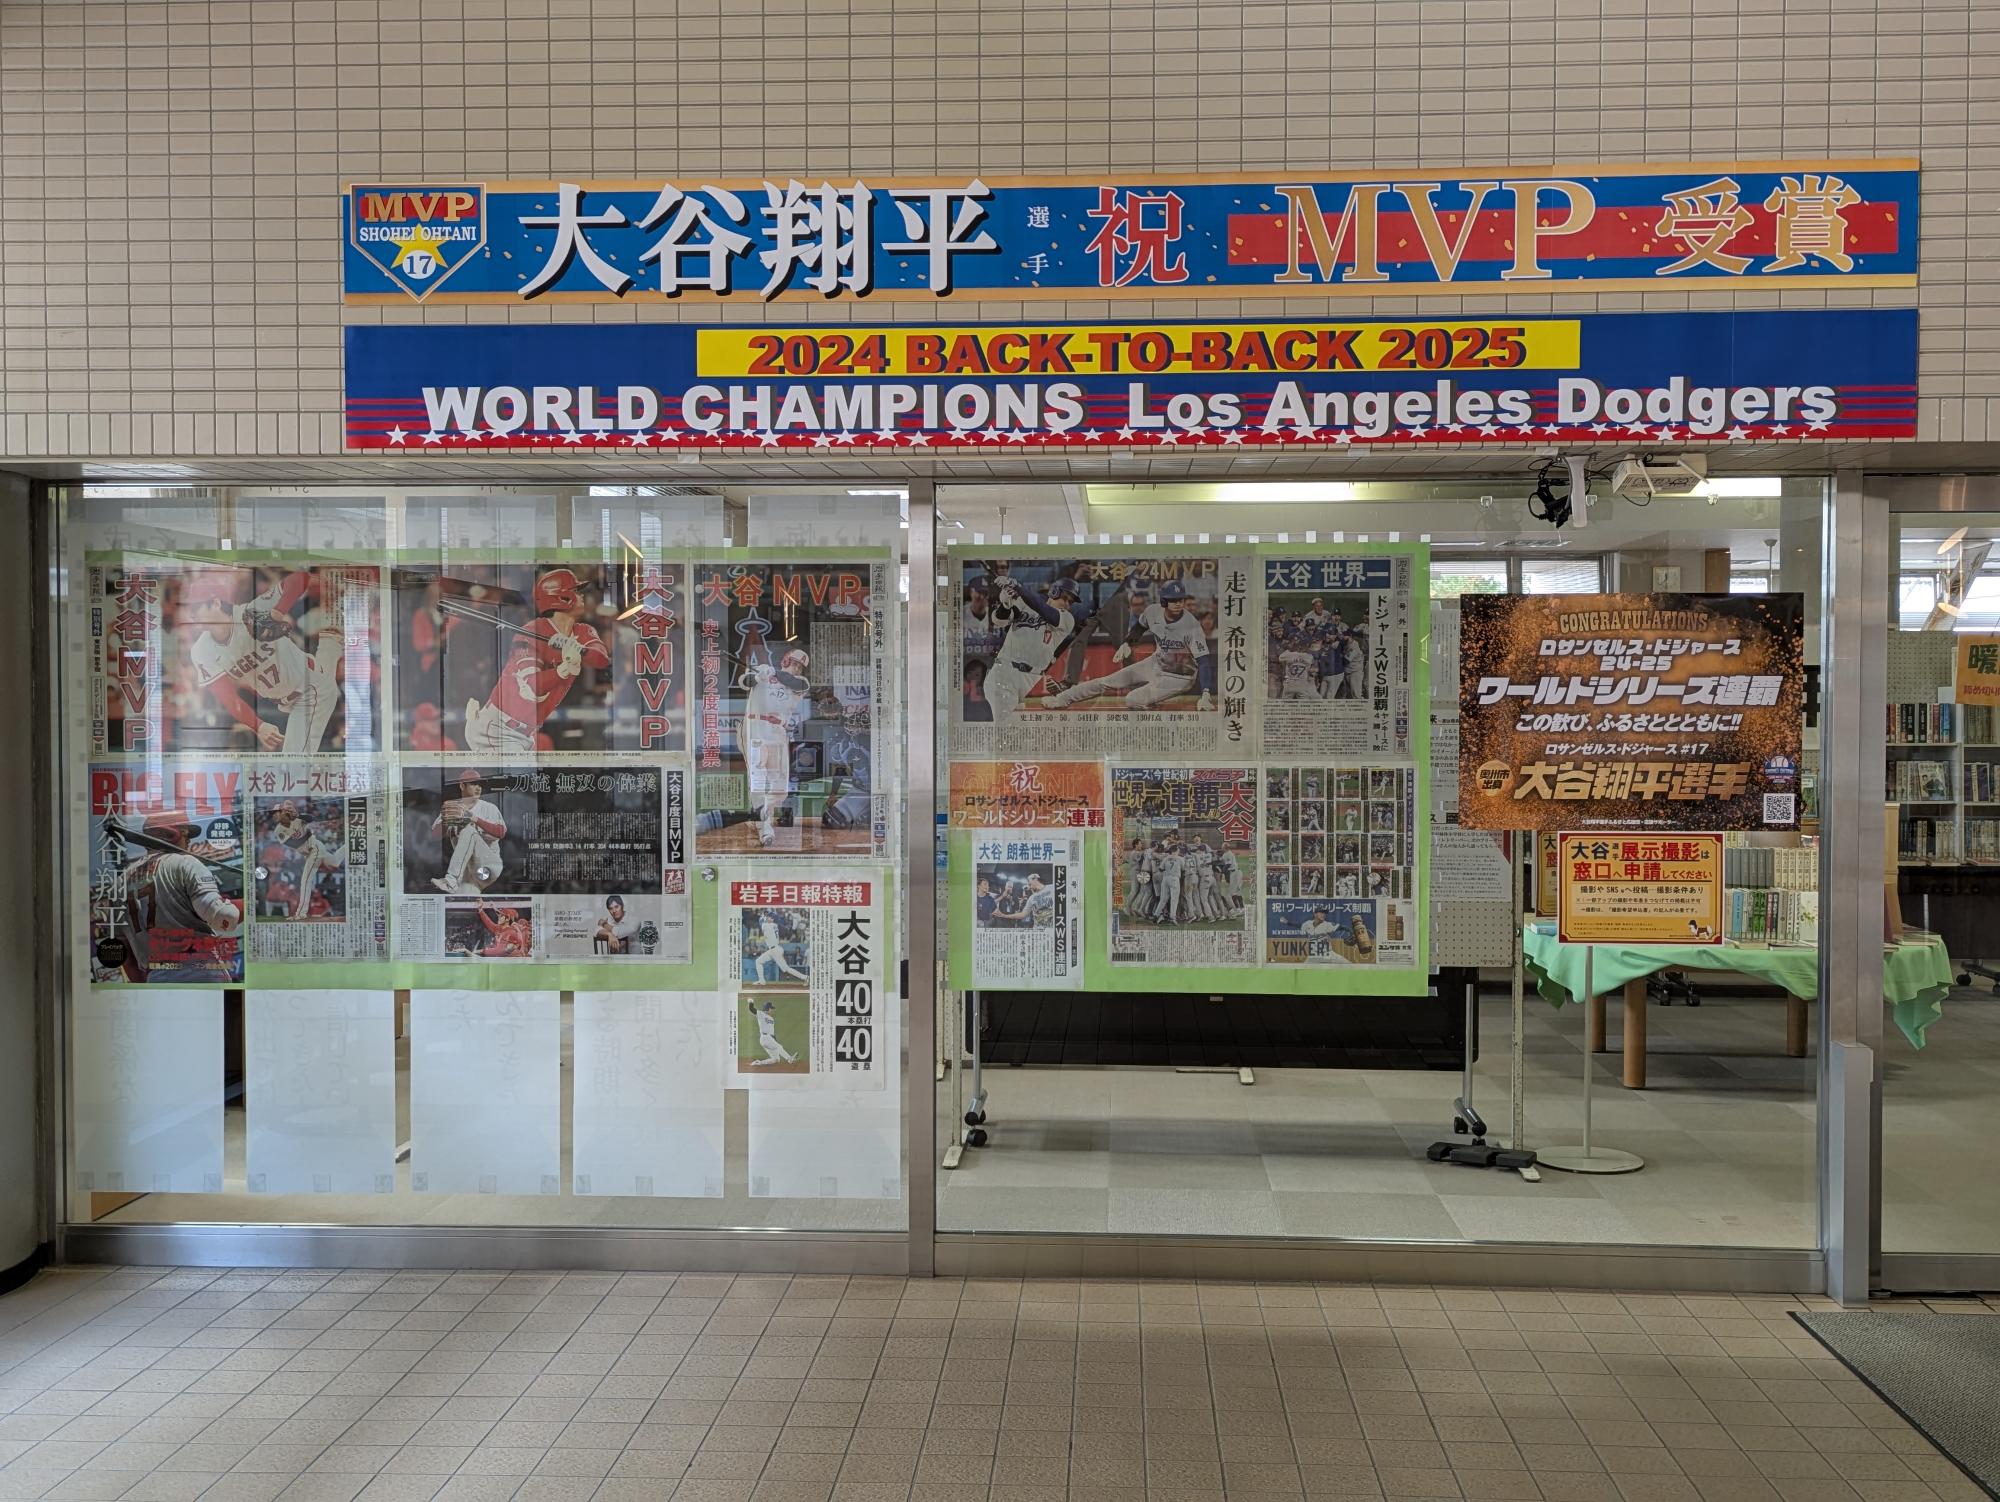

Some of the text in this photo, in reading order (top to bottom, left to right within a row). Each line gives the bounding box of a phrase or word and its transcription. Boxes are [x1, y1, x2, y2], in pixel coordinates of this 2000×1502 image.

[364, 192, 474, 223] MVP
[359, 226, 477, 242] SHOHEI OHTANI
[518, 174, 1870, 299] 大谷翔平 選手 祝 MVP 受賞
[406, 255, 432, 275] 17
[747, 326, 1528, 375] 2024 BACK-TO-BACK 2025
[421, 376, 1838, 438] WORLD CHAMPIONS Los Angeles Dodgers
[1090, 562, 1127, 580] 大谷
[1267, 561, 1389, 588] 大谷 世界一
[702, 574, 862, 607] 大谷 MVP
[874, 610, 885, 649] 特別号外
[1559, 610, 1708, 633] CONGRATULATIONS
[114, 573, 158, 752] 大谷MVP
[632, 567, 673, 748] 大谷MVP
[1224, 571, 1247, 742] 走打 希代の輝き
[1373, 595, 1390, 711] ドジャースWS制覇
[1539, 639, 1742, 656] ロサンゼルス・ドジャース
[1599, 655, 1673, 672] 24-25
[1968, 643, 2000, 675] 暖
[702, 618, 720, 768] 史上初2度目満票
[1477, 675, 1784, 706] ワールドシリーズ連覇
[1545, 743, 1709, 756] ロサンゼルス・ドジャース #17
[174, 772, 240, 815] FLY
[248, 771, 277, 793] 大谷
[281, 771, 367, 793] ルースに並ぶ
[490, 772, 657, 793] 二刀流 無双の偉業
[1010, 763, 1043, 793] 祝
[1512, 761, 1752, 801] 大谷翔平選手
[965, 795, 1089, 807] ロサンゼルス・ドジャース
[1218, 782, 1256, 842] 大谷
[350, 798, 368, 865] 二刀流13勝
[668, 772, 682, 863] 大谷2度目MVP
[952, 808, 1106, 828] ワールドシリーズ連覇
[94, 792, 129, 940] 大谷翔平
[978, 843, 1066, 861] 大谷 朗希世界一
[1573, 862, 1713, 881] 窓口へ申請してください
[738, 885, 863, 904] 岩手日報特報
[1055, 867, 1067, 976] ドジャースWS連覇
[837, 910, 871, 975] 大谷
[1272, 941, 1330, 957] YUNKER!
[836, 982, 872, 1014] 40
[848, 1016, 872, 1025] 本塁打
[836, 1027, 872, 1061] 40
